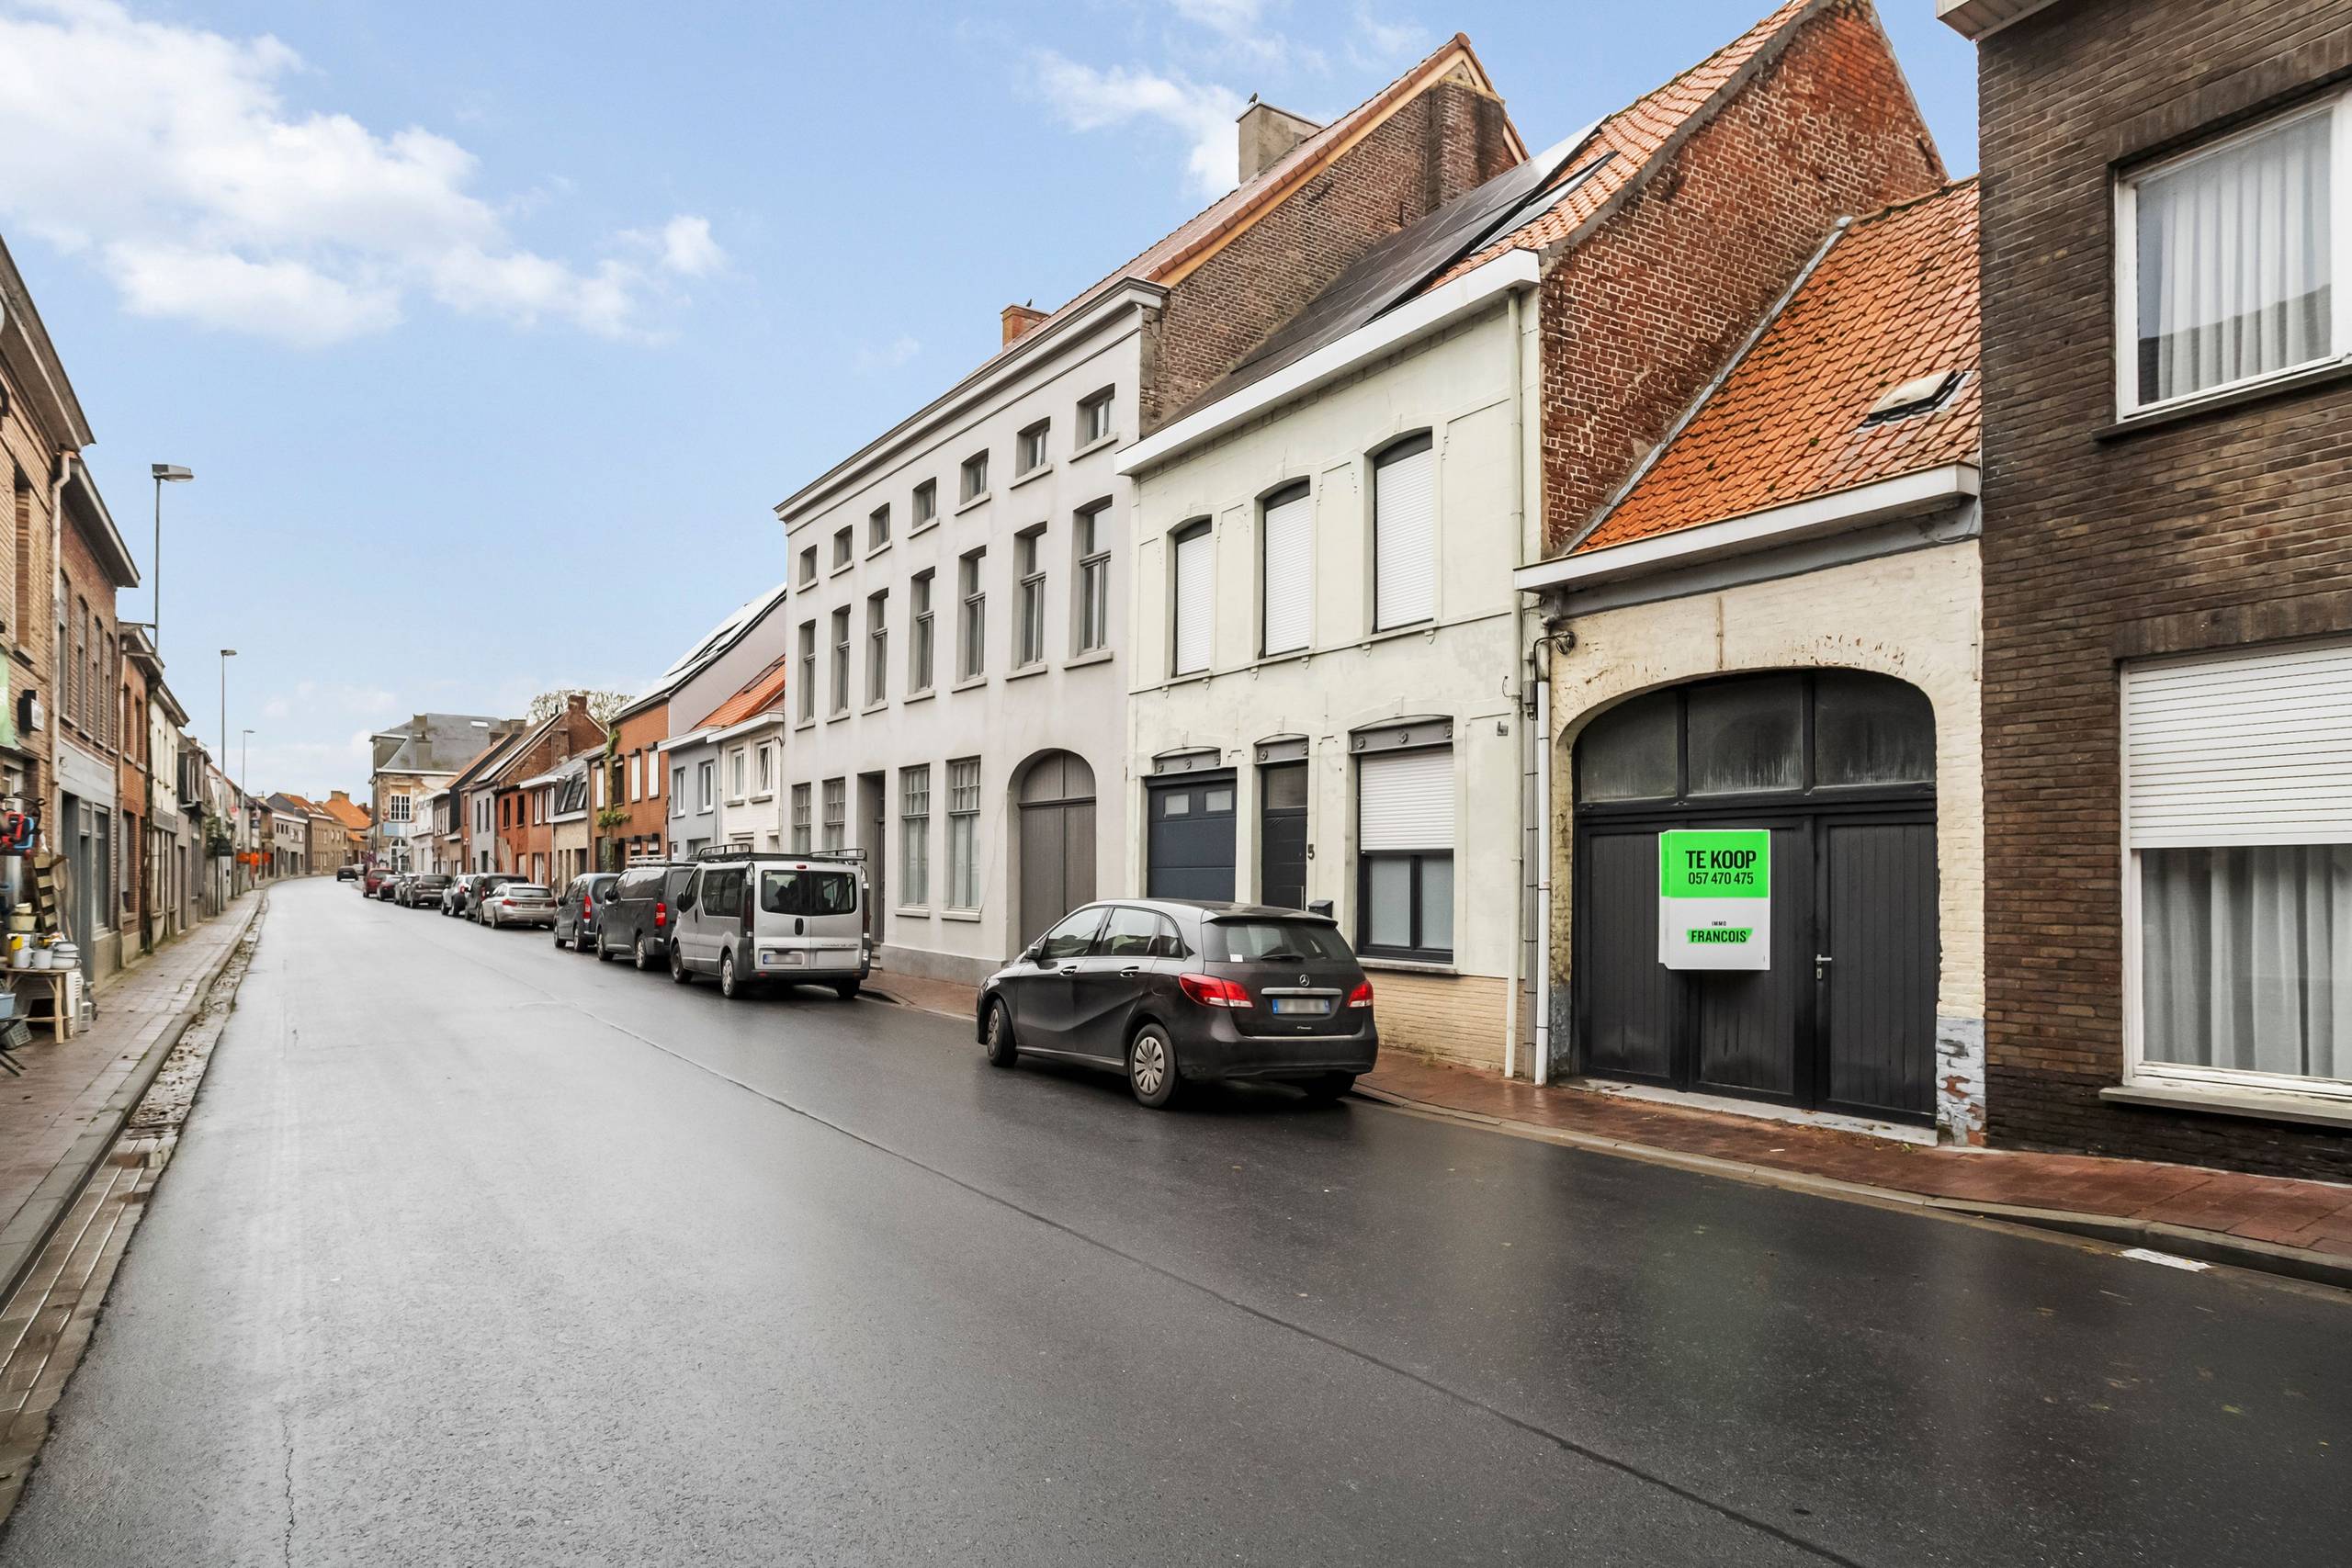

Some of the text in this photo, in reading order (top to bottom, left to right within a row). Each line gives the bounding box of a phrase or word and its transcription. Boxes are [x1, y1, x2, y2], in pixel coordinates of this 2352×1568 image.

[1307, 844, 1315, 860] 5
[1685, 850, 1757, 869] TE KOOP
[1688, 872, 1754, 885] 057 470 475
[1690, 930, 1747, 942] FRANCOIS
